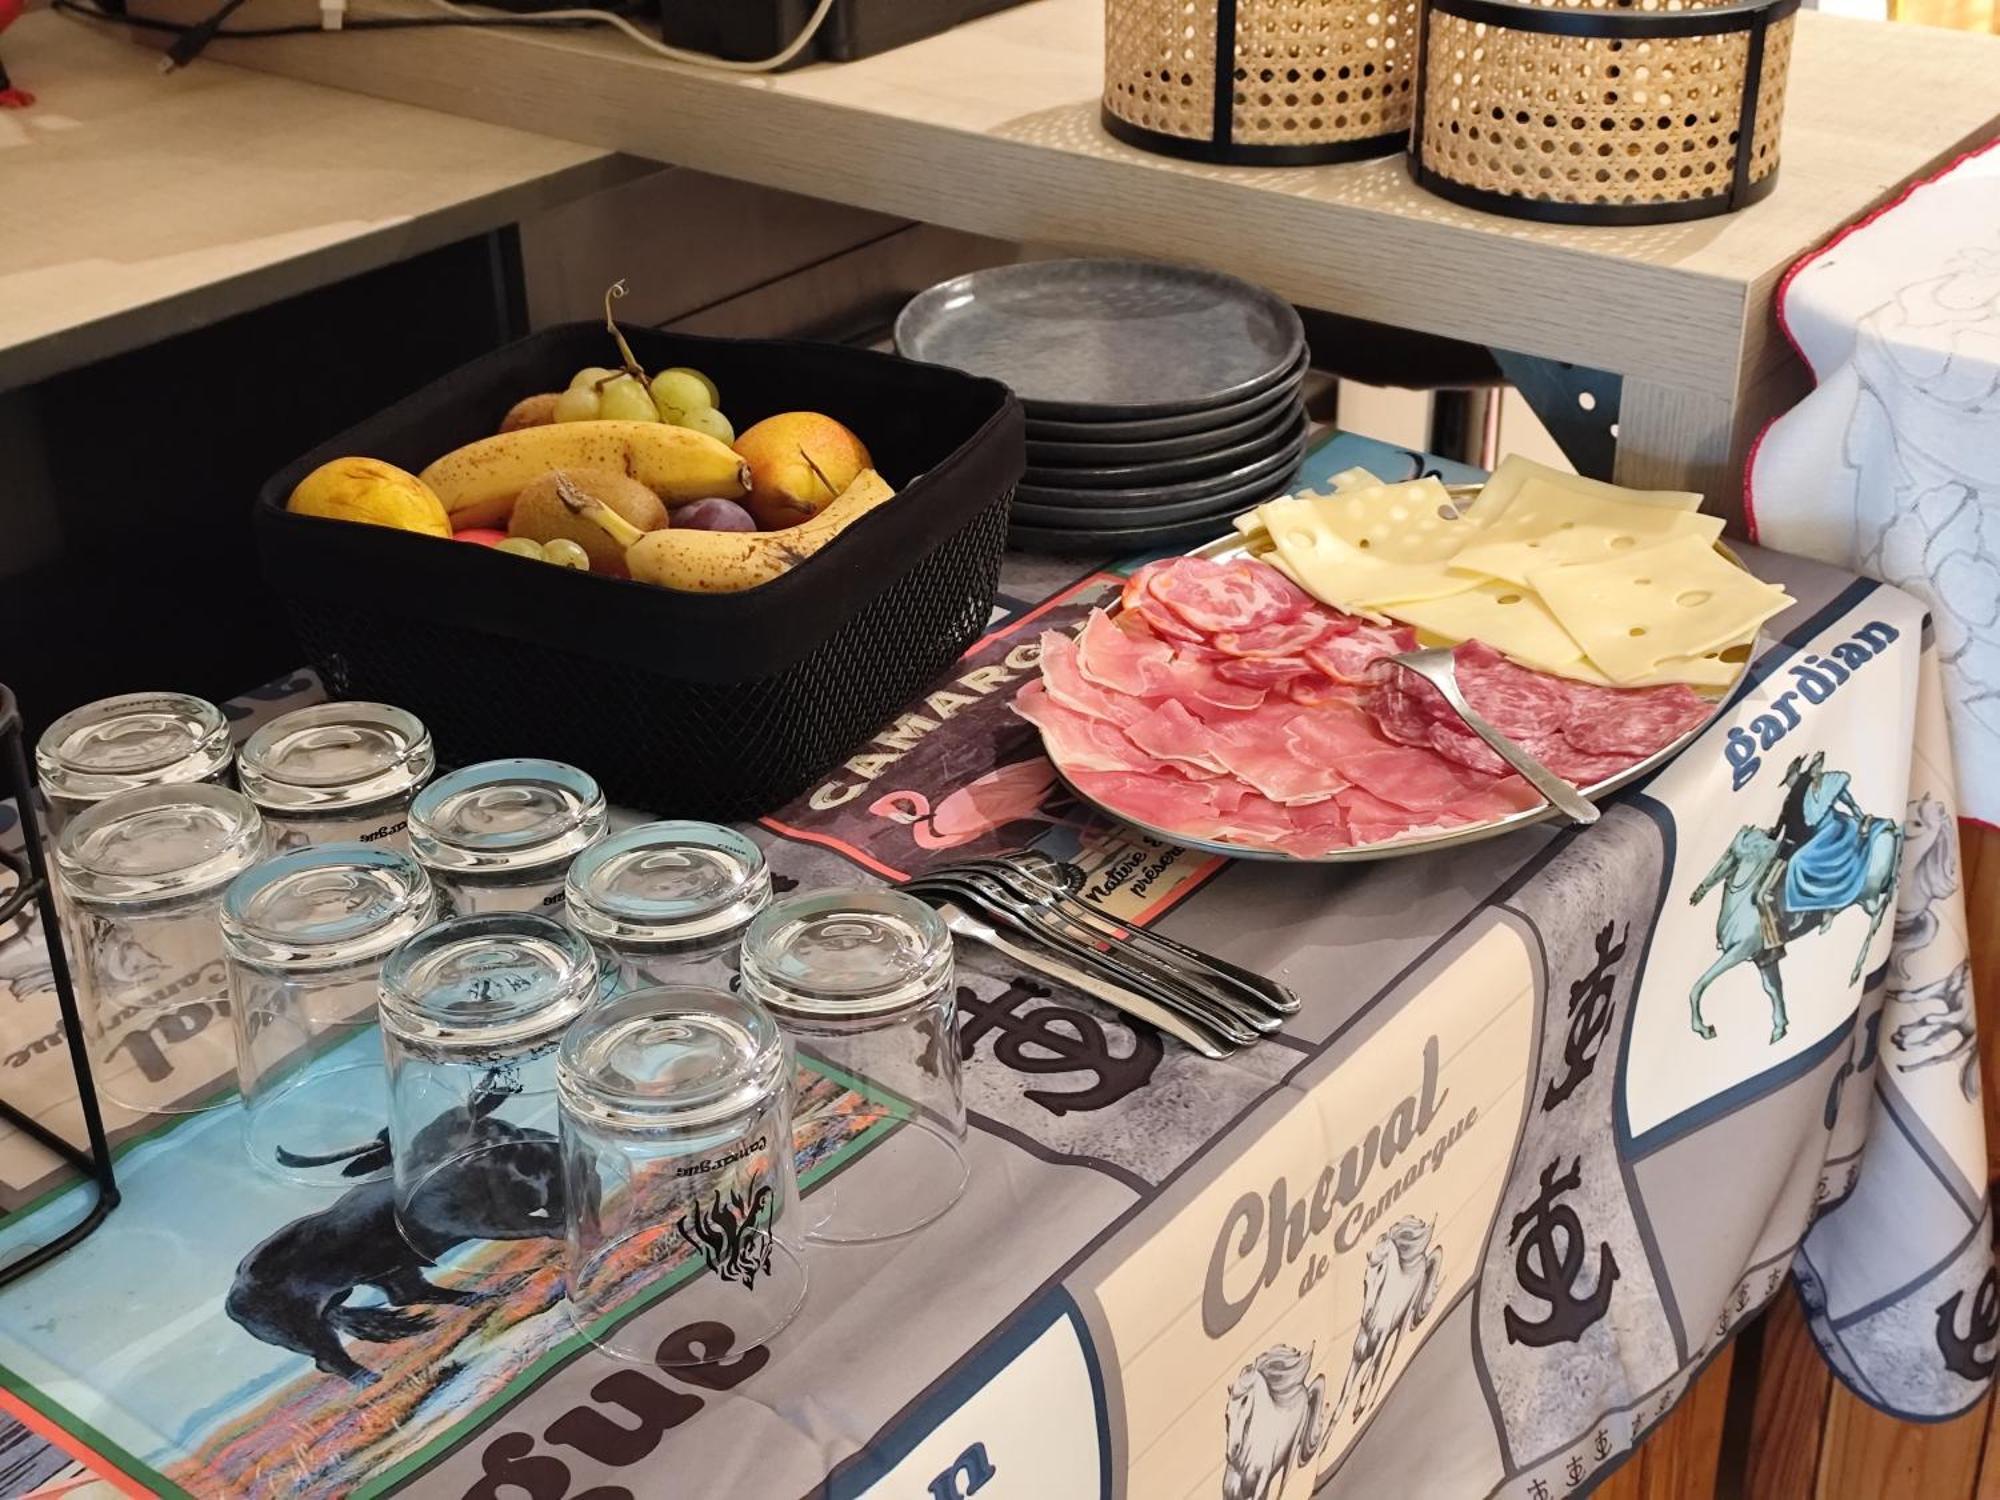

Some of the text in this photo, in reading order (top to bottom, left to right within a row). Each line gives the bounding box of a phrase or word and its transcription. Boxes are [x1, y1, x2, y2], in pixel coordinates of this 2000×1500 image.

[808, 643, 1043, 811] CAMARG
[1724, 620, 1900, 792] gardian
[1201, 1034, 1450, 1340] Cheval
[1297, 1106, 1479, 1299] de Camargue
